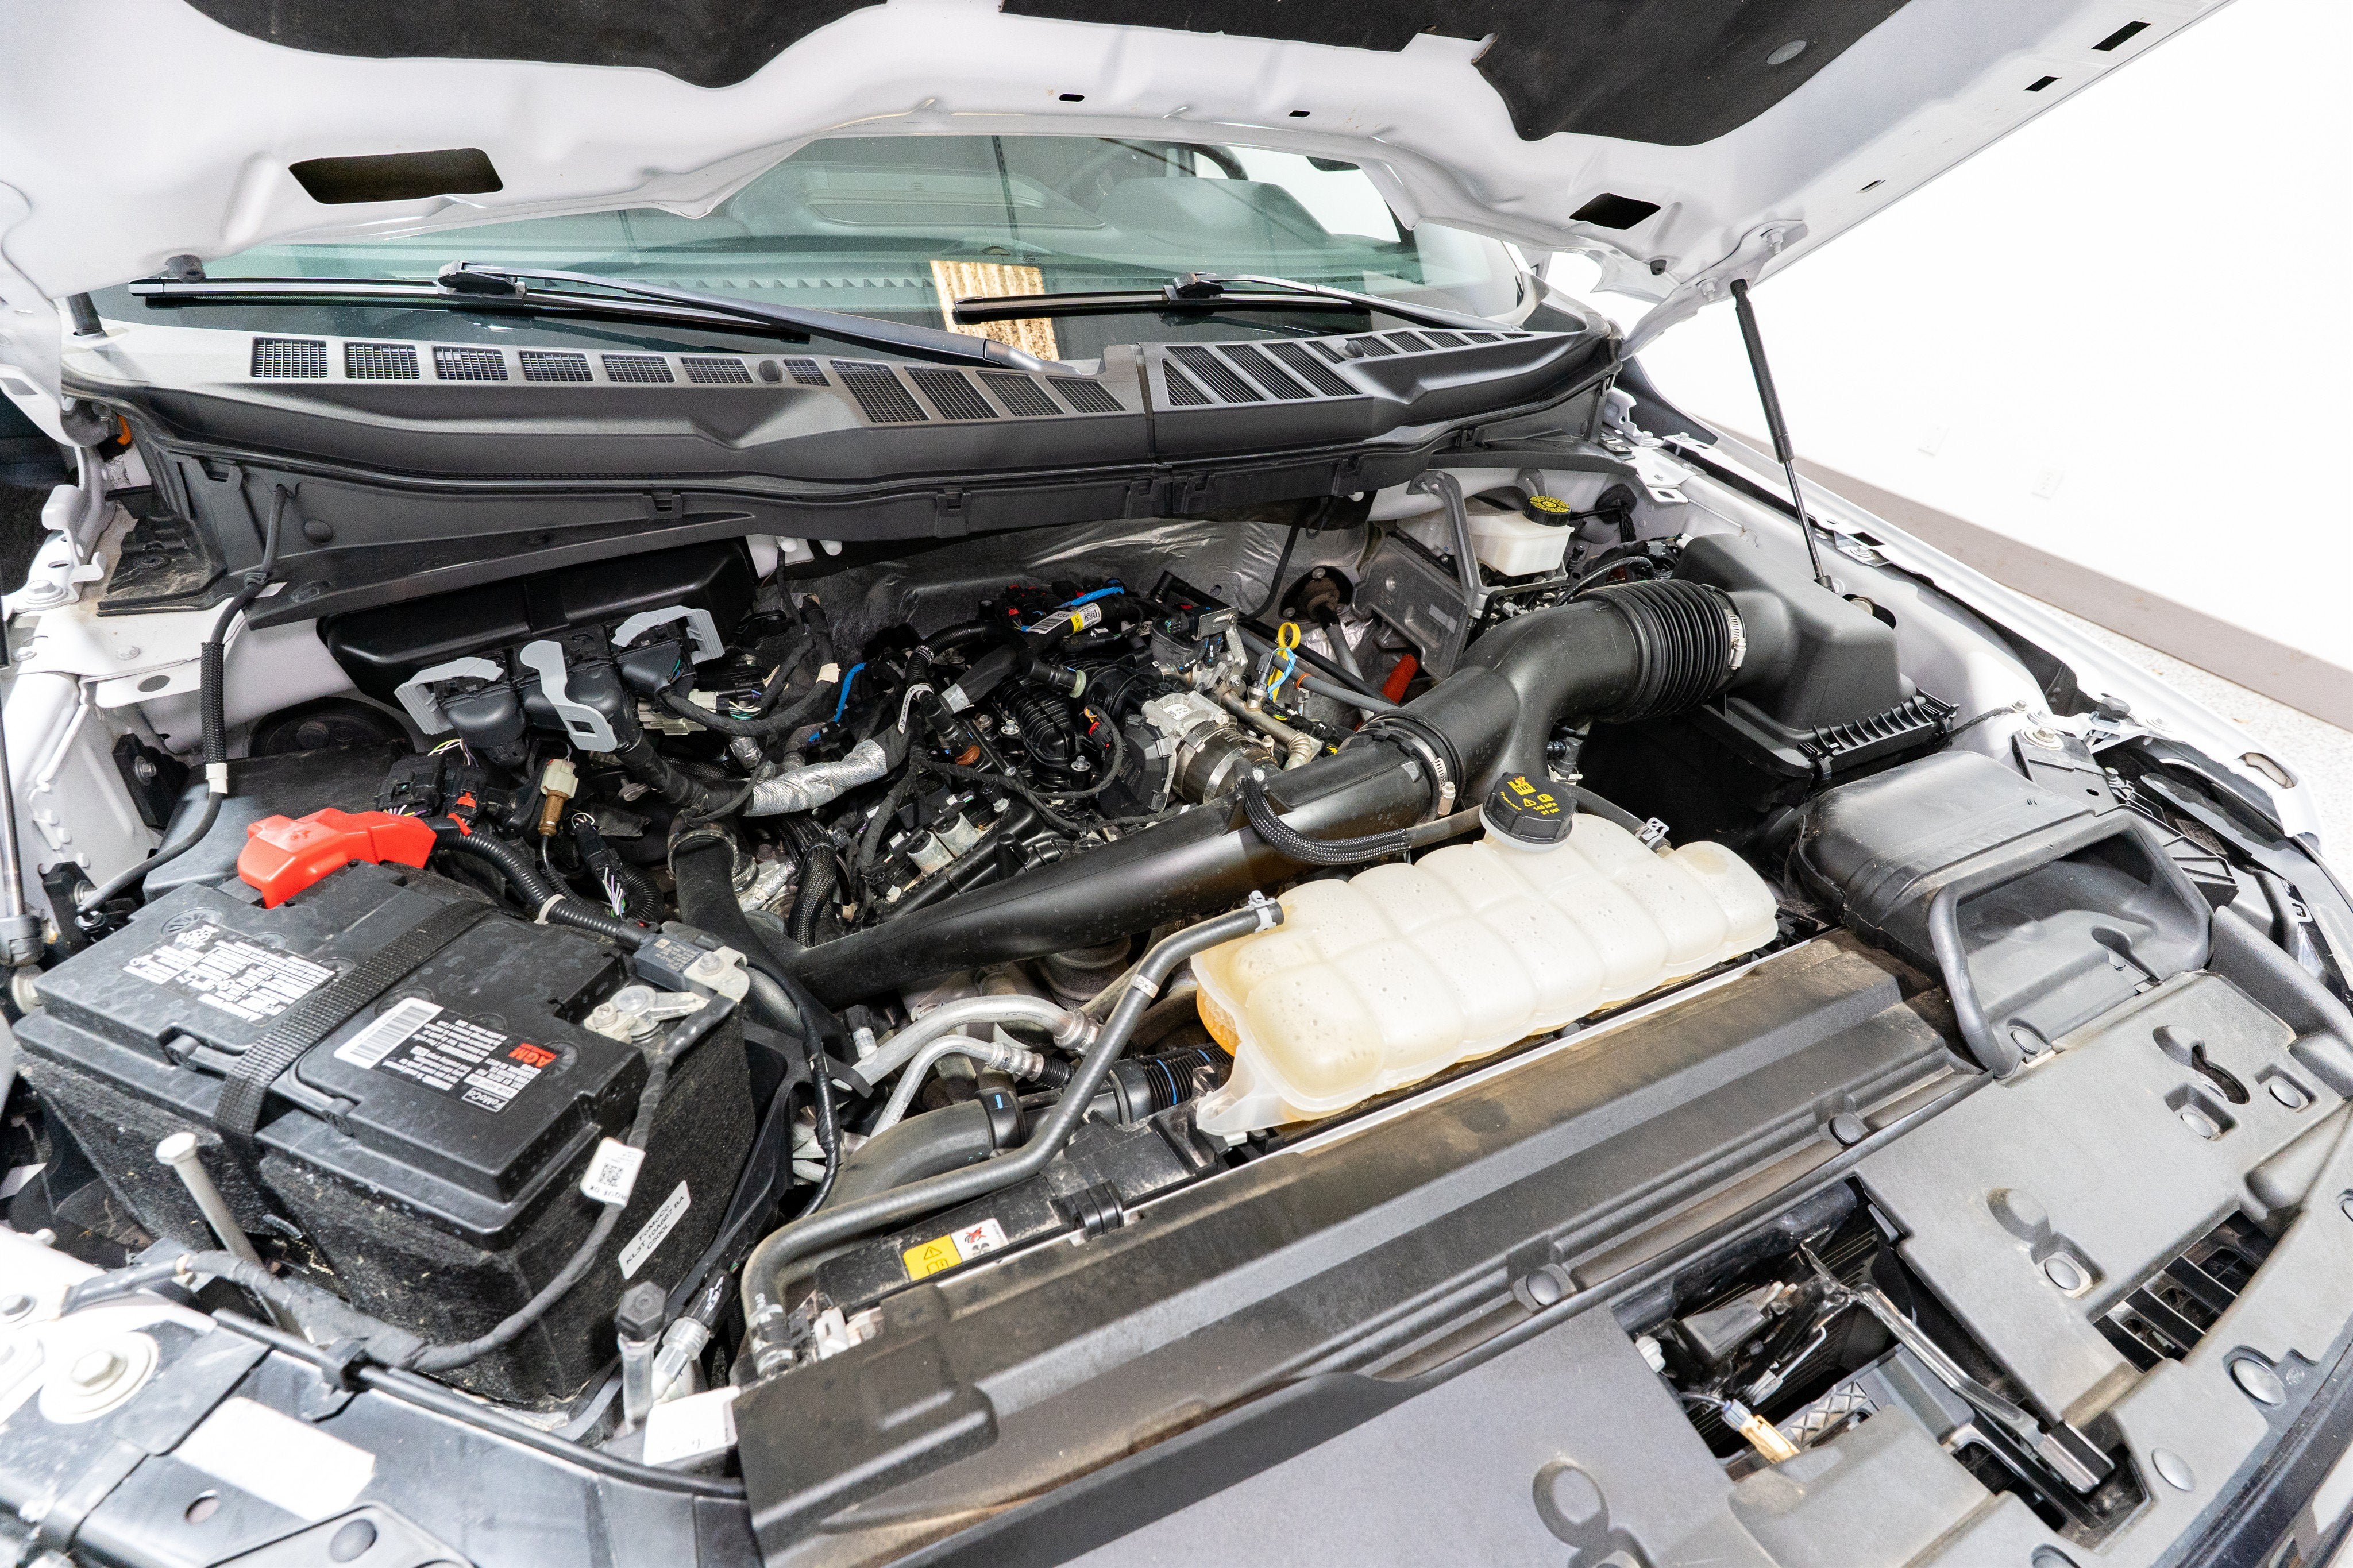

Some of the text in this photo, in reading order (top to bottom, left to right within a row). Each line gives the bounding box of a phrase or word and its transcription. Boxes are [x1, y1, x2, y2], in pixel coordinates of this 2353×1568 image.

[507, 1046, 553, 1069] AGM
[465, 1089, 506, 1109] FoMoCo
[627, 1196, 684, 1264] KL3T 10A687 BA
[639, 1205, 670, 1241] FoMoCo
[647, 1224, 670, 1249] C500L
